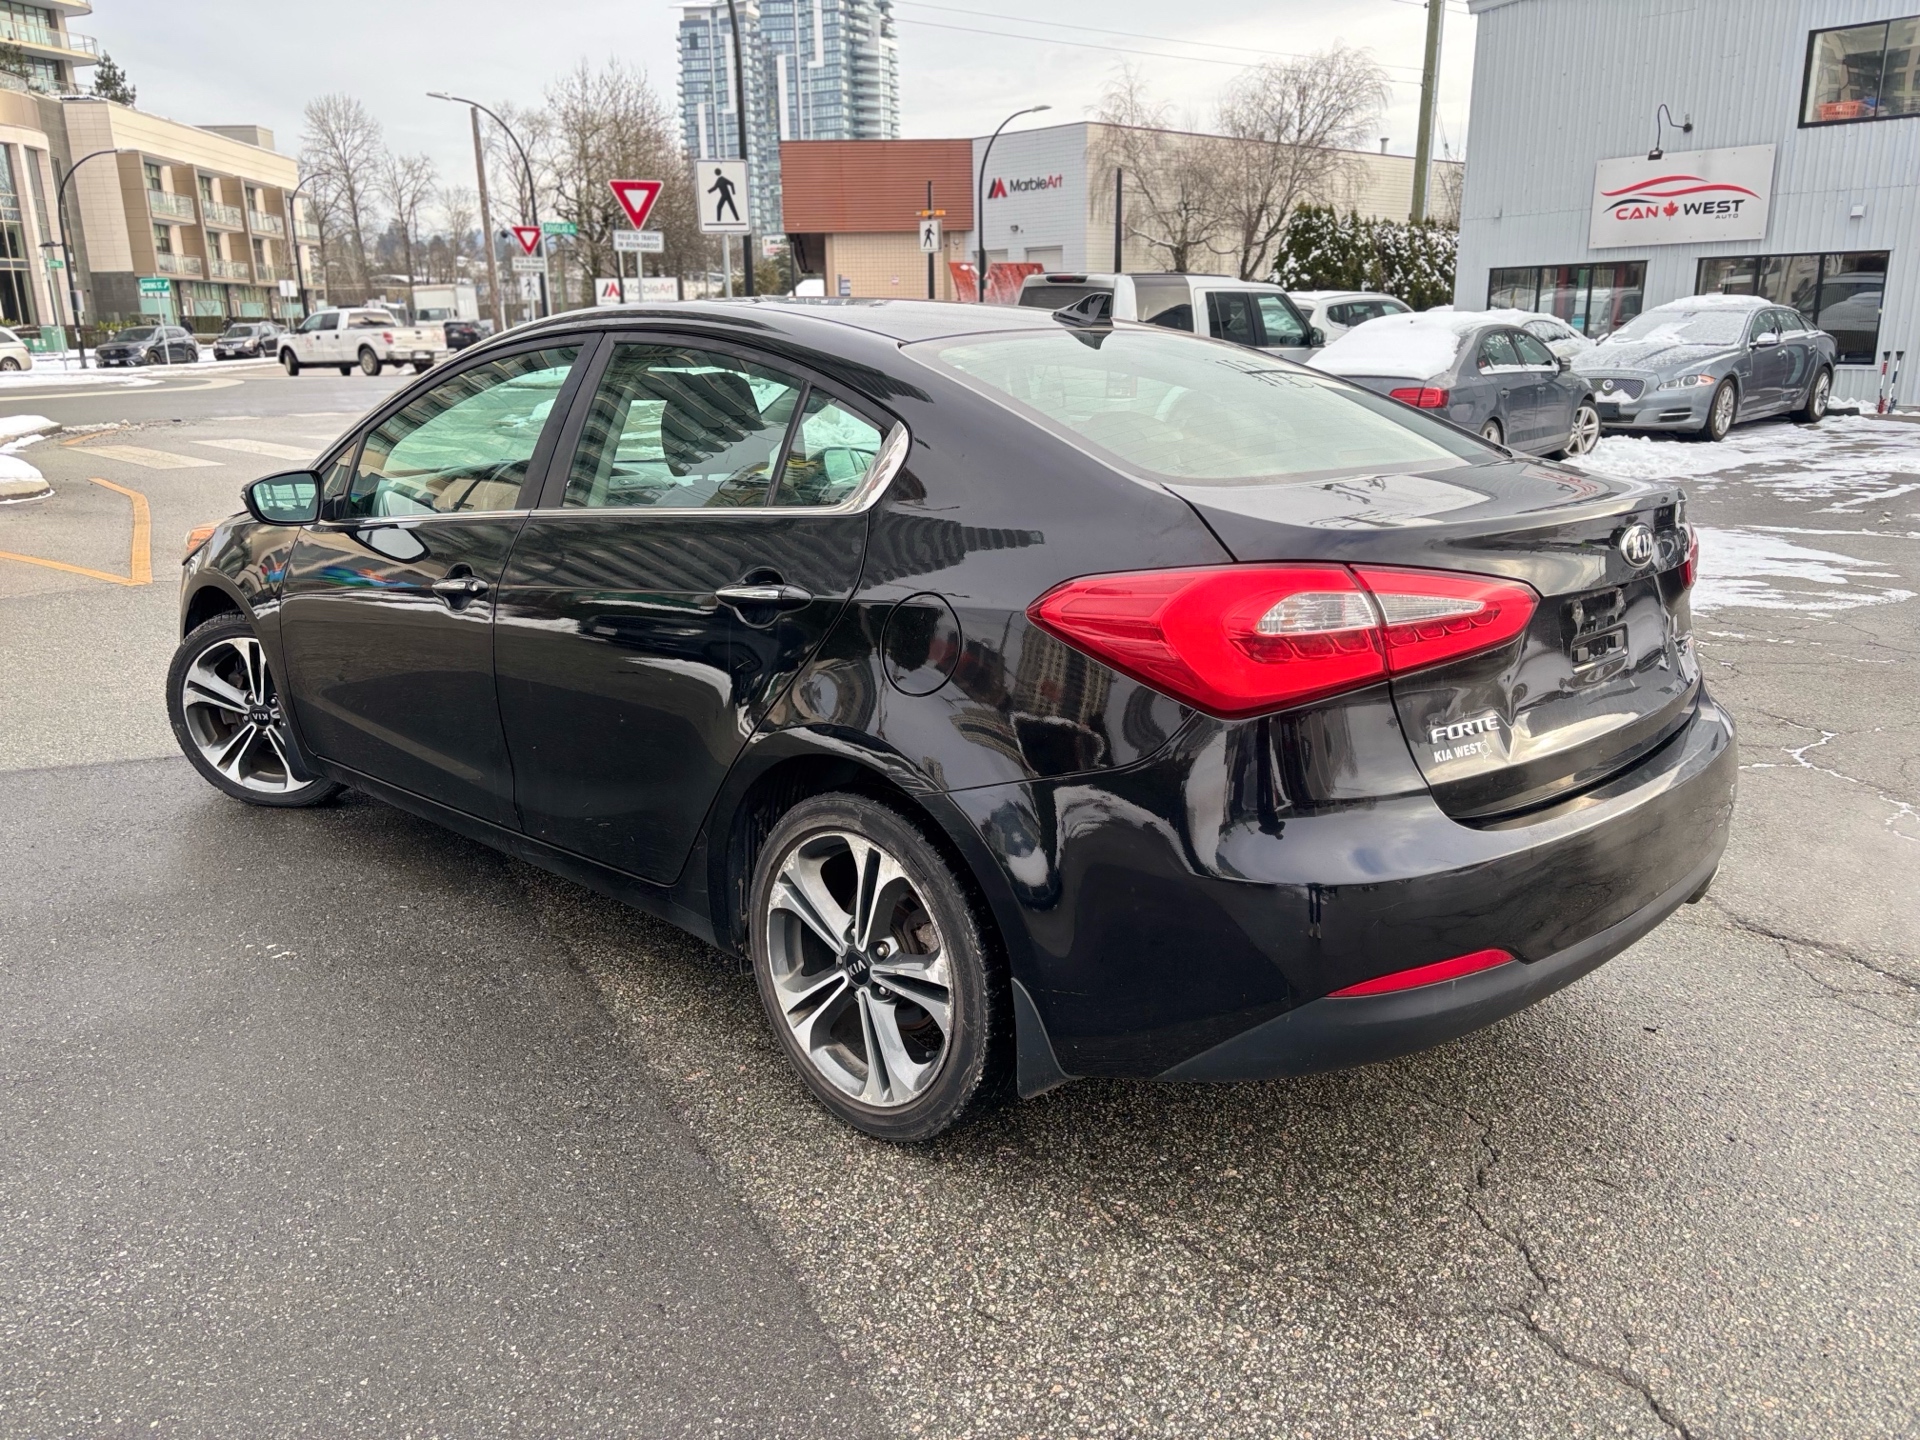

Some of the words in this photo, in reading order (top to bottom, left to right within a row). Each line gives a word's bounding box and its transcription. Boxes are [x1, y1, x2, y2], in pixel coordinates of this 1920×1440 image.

[1009, 174, 1063, 192] MarbleArt
[1615, 205, 1659, 220] CAN
[1683, 199, 1745, 215] WEST
[623, 283, 674, 294] MableArt
[1630, 532, 1653, 560] KIA
[252, 711, 269, 721] KIA
[1430, 716, 1500, 744] FORTE
[1433, 750, 1454, 763] KIA
[1454, 742, 1481, 758] WEST
[847, 960, 867, 977] KIA
